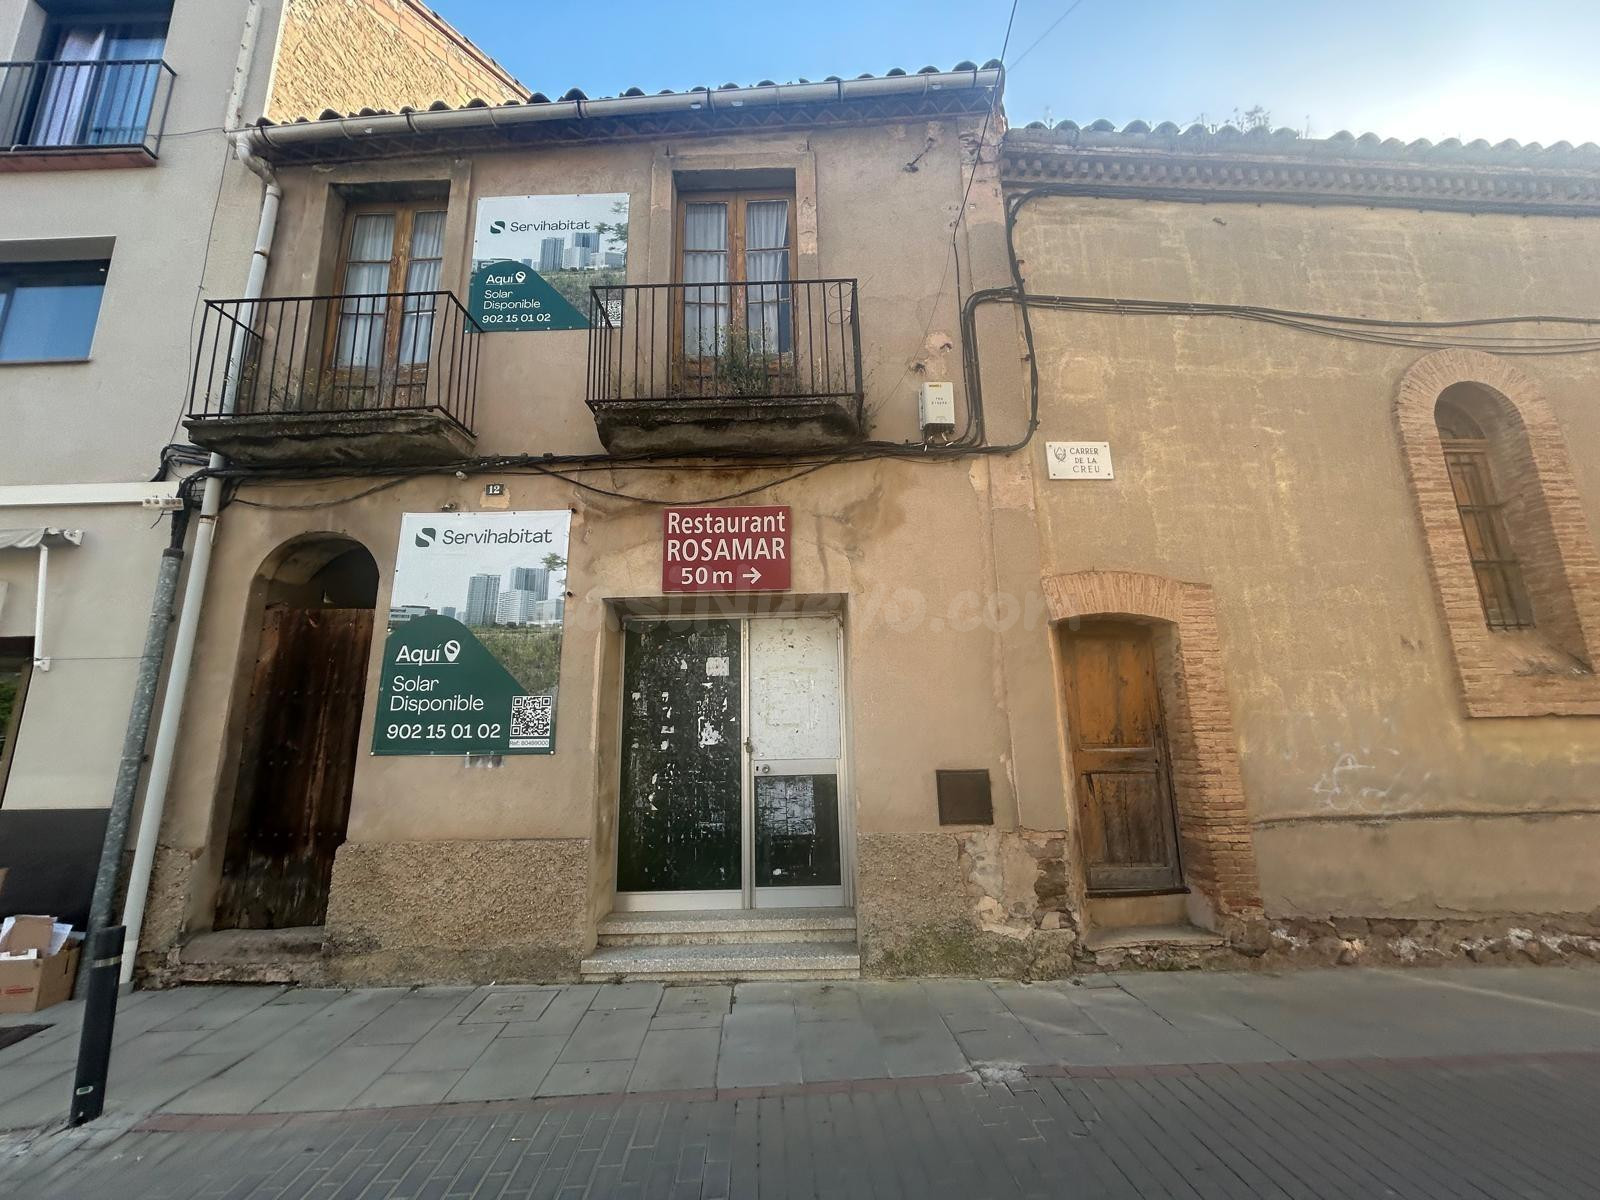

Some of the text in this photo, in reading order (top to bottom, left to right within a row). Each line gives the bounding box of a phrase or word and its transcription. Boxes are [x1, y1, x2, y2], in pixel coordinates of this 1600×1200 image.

[510, 220, 590, 232] Servihabitat
[486, 273, 513, 286] Aquí
[484, 289, 513, 299] Solar
[483, 299, 541, 311] Disponible
[481, 313, 551, 324] 902 15 01 02
[1069, 447, 1099, 455] CARRER
[1072, 465, 1100, 473] CREU
[488, 484, 500, 494] 12
[667, 511, 785, 534] Restaurant
[442, 528, 553, 546] Servihabitat
[667, 537, 785, 562] ROSAMAR
[395, 643, 442, 666] Aquí
[392, 675, 440, 692] Solar
[390, 694, 484, 715] Disponible
[386, 723, 501, 739] 902 15 01 02
